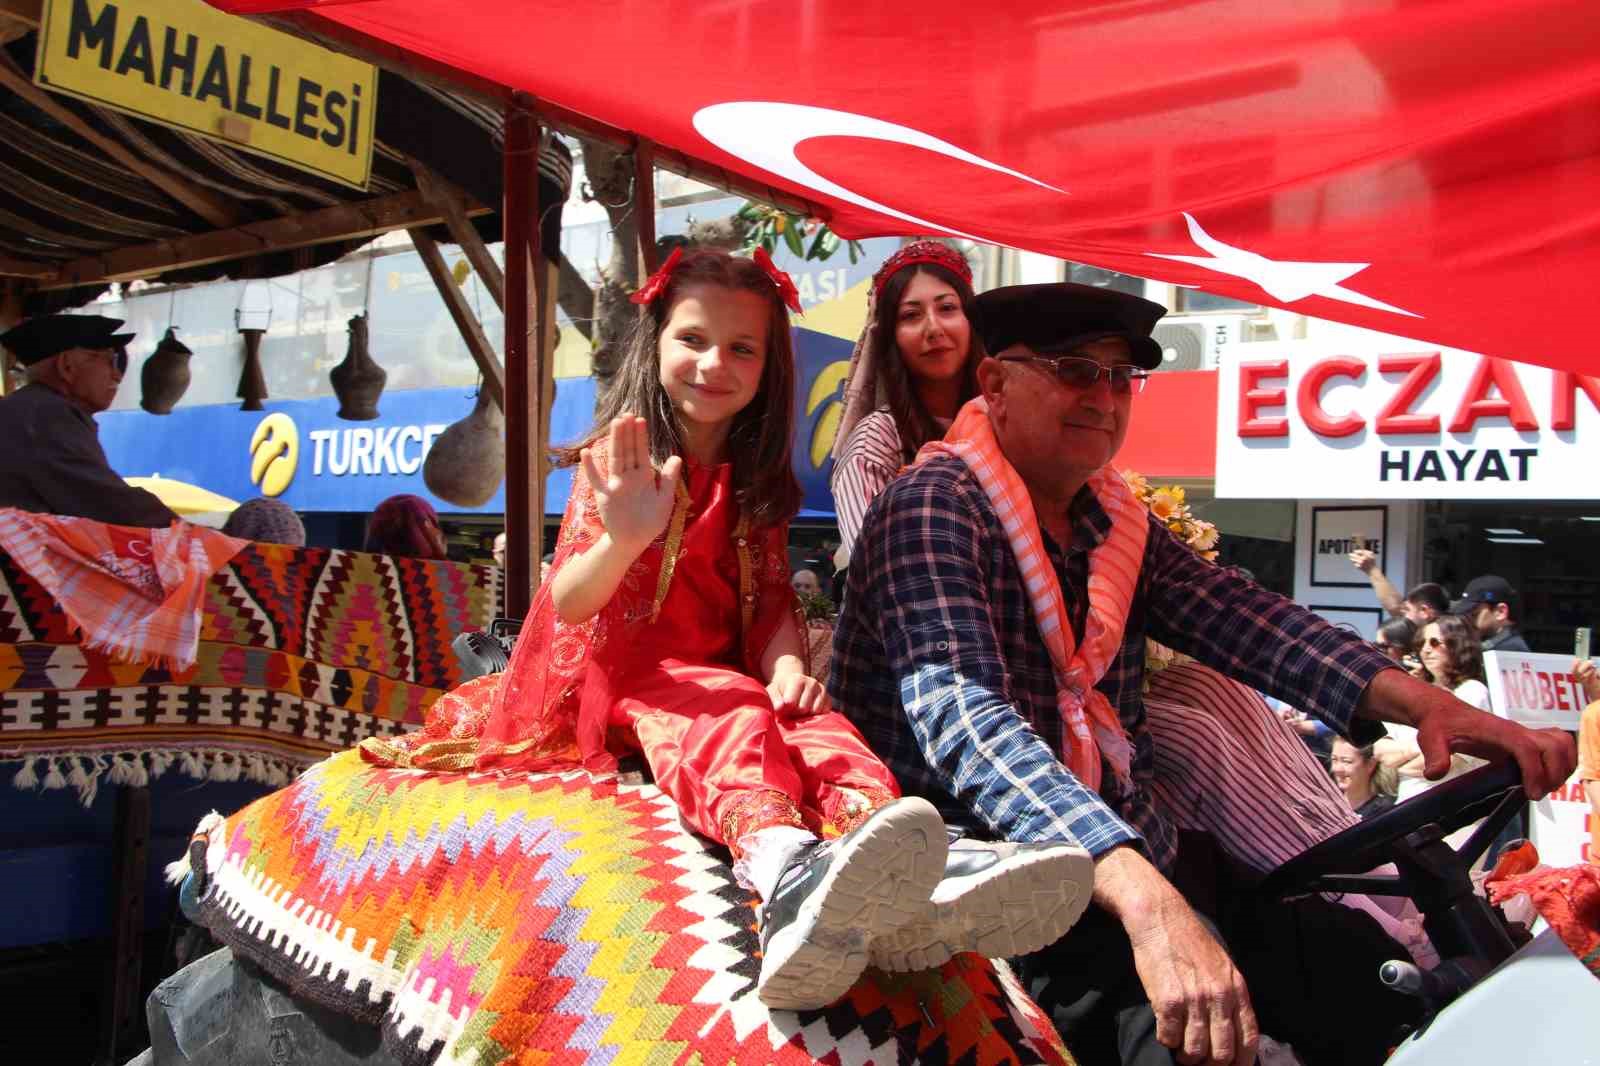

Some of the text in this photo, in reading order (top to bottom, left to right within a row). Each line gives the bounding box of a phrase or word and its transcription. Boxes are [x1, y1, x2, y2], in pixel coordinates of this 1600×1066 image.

[67, 0, 361, 156] MAHALLESİ
[793, 268, 848, 302] ASI
[1379, 448, 1538, 482] HAYAT
[1318, 538, 1380, 555] APOTKE
[1502, 661, 1591, 712] NÖBET
